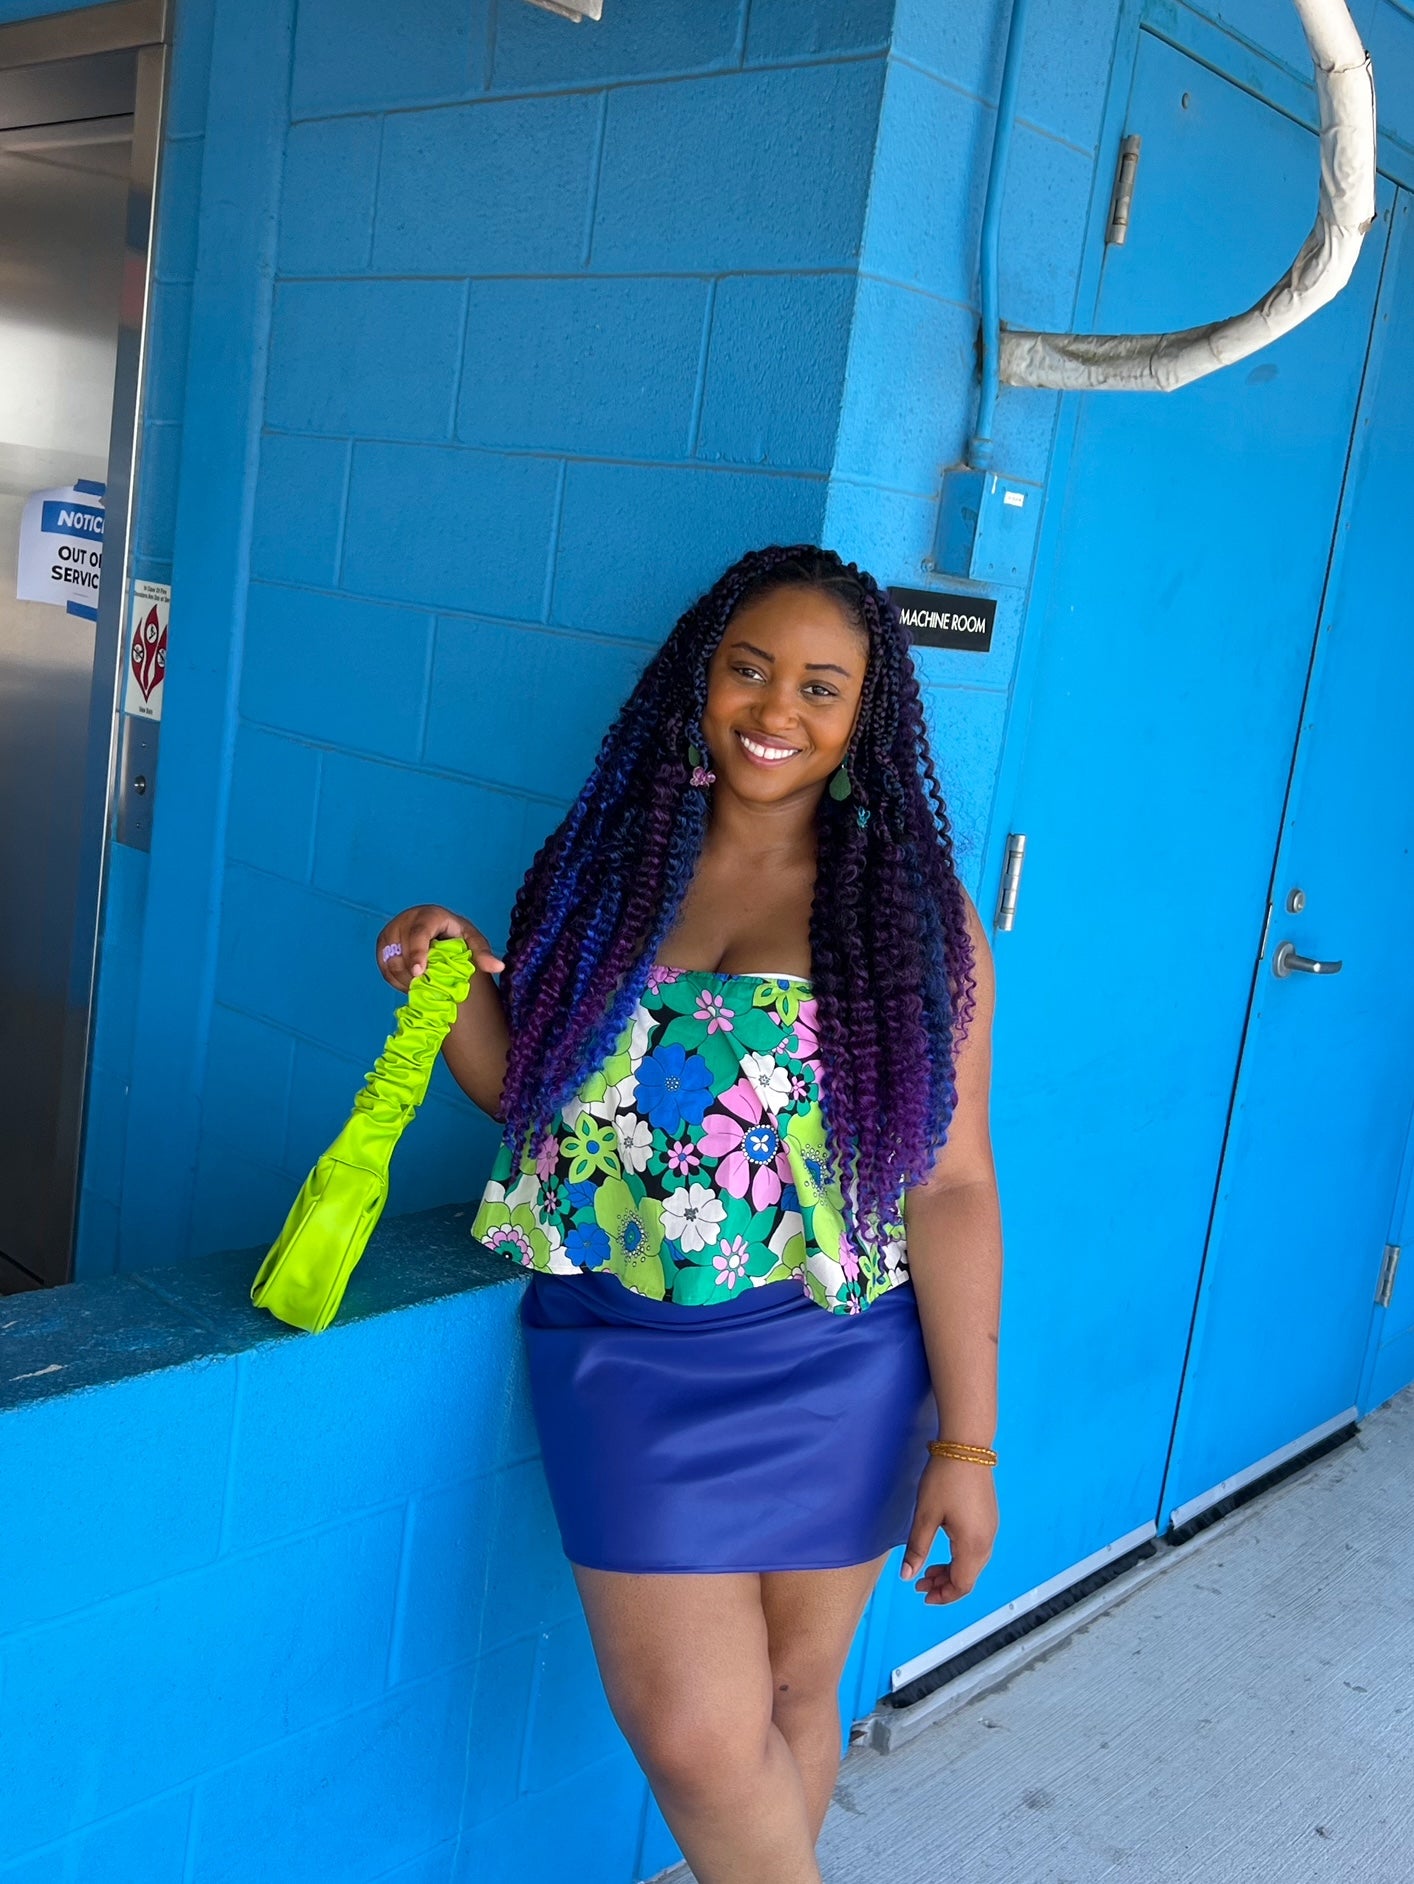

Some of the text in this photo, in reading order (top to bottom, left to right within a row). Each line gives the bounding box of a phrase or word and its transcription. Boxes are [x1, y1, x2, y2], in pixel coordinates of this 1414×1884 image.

[57, 509, 104, 534] NOTIC
[58, 545, 102, 569] OUT O
[51, 565, 99, 589] SERVIC
[899, 608, 986, 634] MACHINE ROOM
